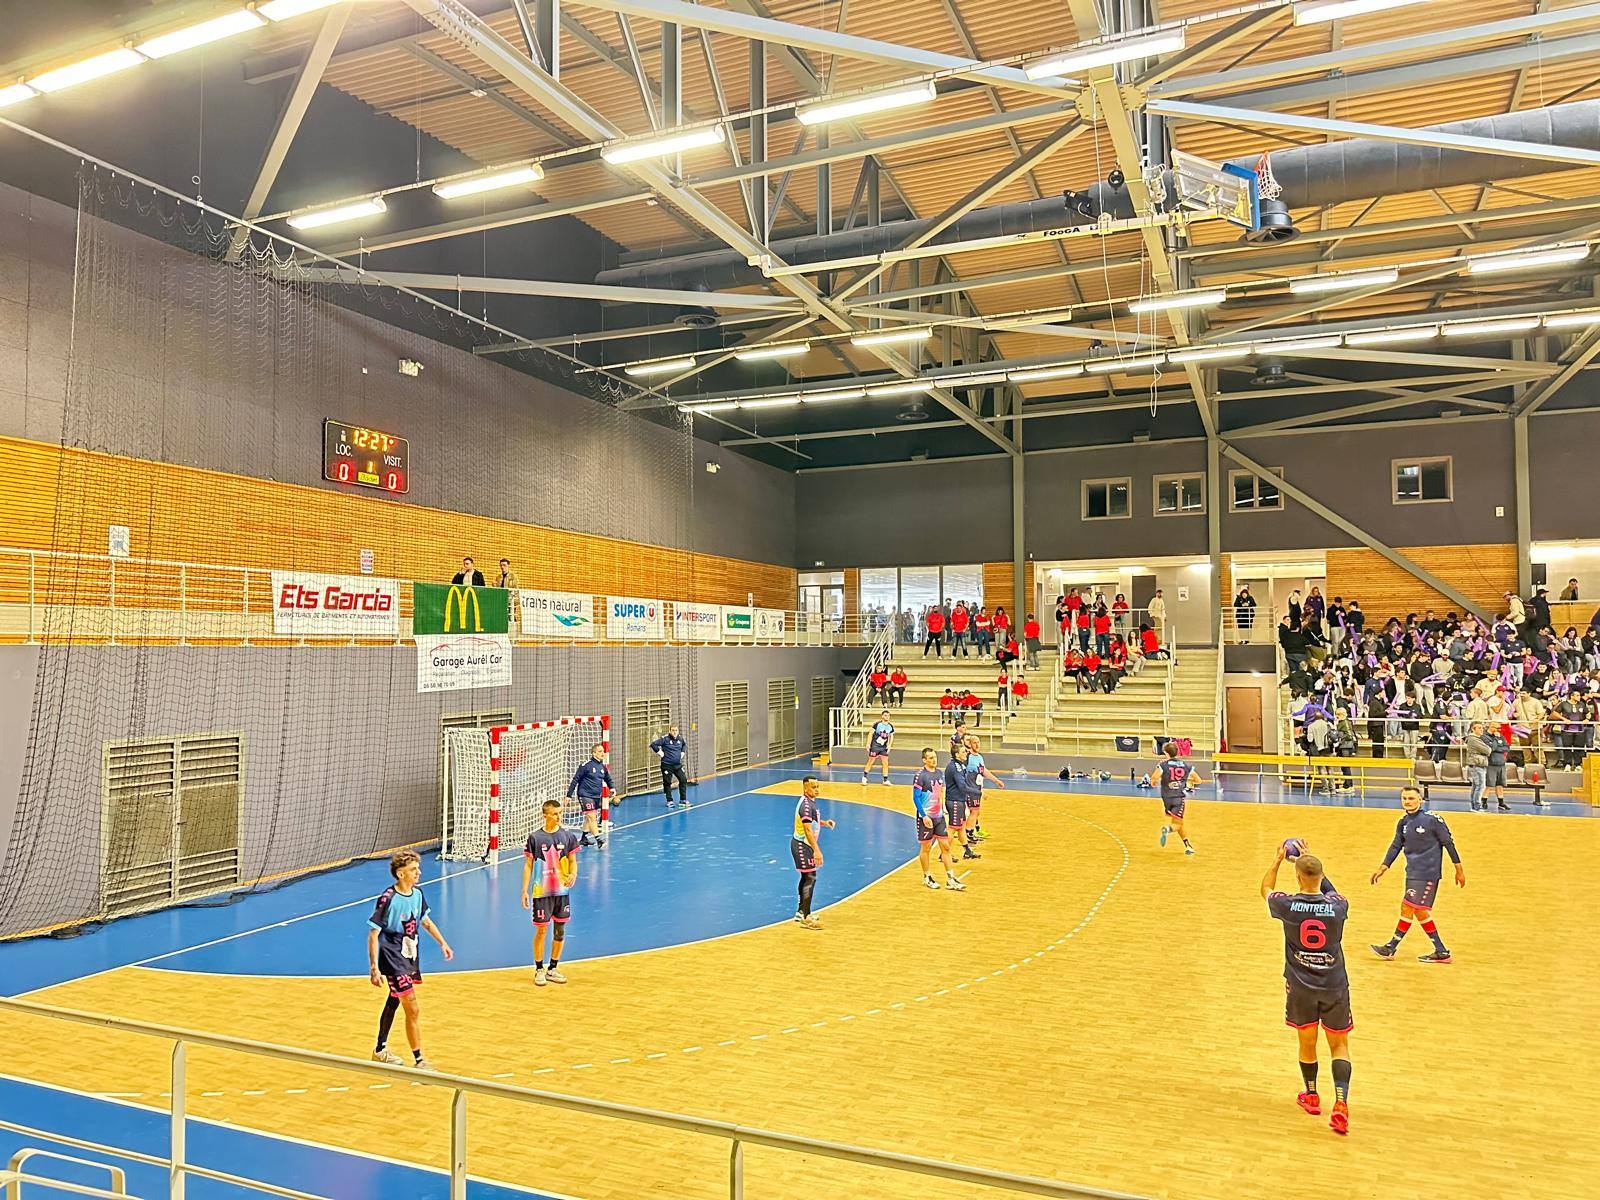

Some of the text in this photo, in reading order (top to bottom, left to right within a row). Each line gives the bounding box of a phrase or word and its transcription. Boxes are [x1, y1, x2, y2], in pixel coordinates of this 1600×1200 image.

[335, 443, 353, 457] LOC.
[383, 454, 402, 468] VISIT.
[339, 463, 349, 481] 0
[388, 473, 397, 490] 0
[279, 584, 392, 611] Ets Garcia
[522, 595, 582, 613] trans natural
[614, 603, 646, 618] SUPER
[432, 655, 503, 668] Garage Aurél Car
[1168, 766, 1186, 781] 19
[923, 831, 930, 839] 7
[1290, 901, 1335, 913] MONTREAL
[1300, 919, 1327, 949] 6
